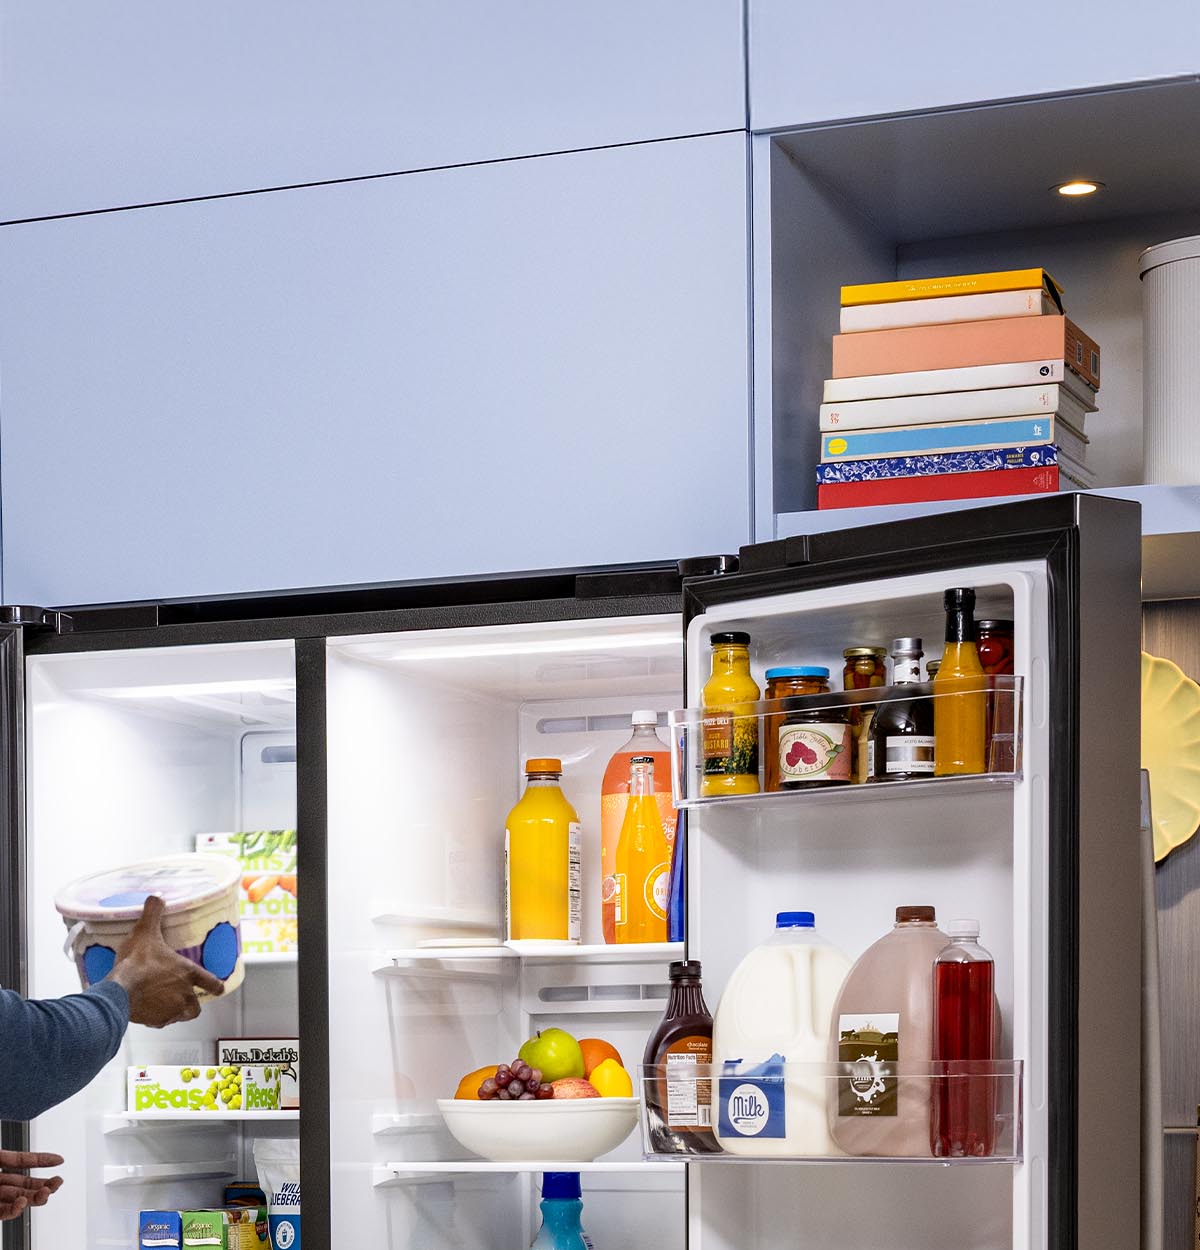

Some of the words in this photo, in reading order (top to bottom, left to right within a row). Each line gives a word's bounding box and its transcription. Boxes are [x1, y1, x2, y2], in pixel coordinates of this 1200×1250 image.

[223, 1049, 250, 1062] Mrs.
[251, 1048, 298, 1062] Dekab's
[135, 1088, 204, 1110] peas
[246, 1087, 274, 1110] peas
[732, 1095, 765, 1119] Milk
[189, 1222, 212, 1230] organic
